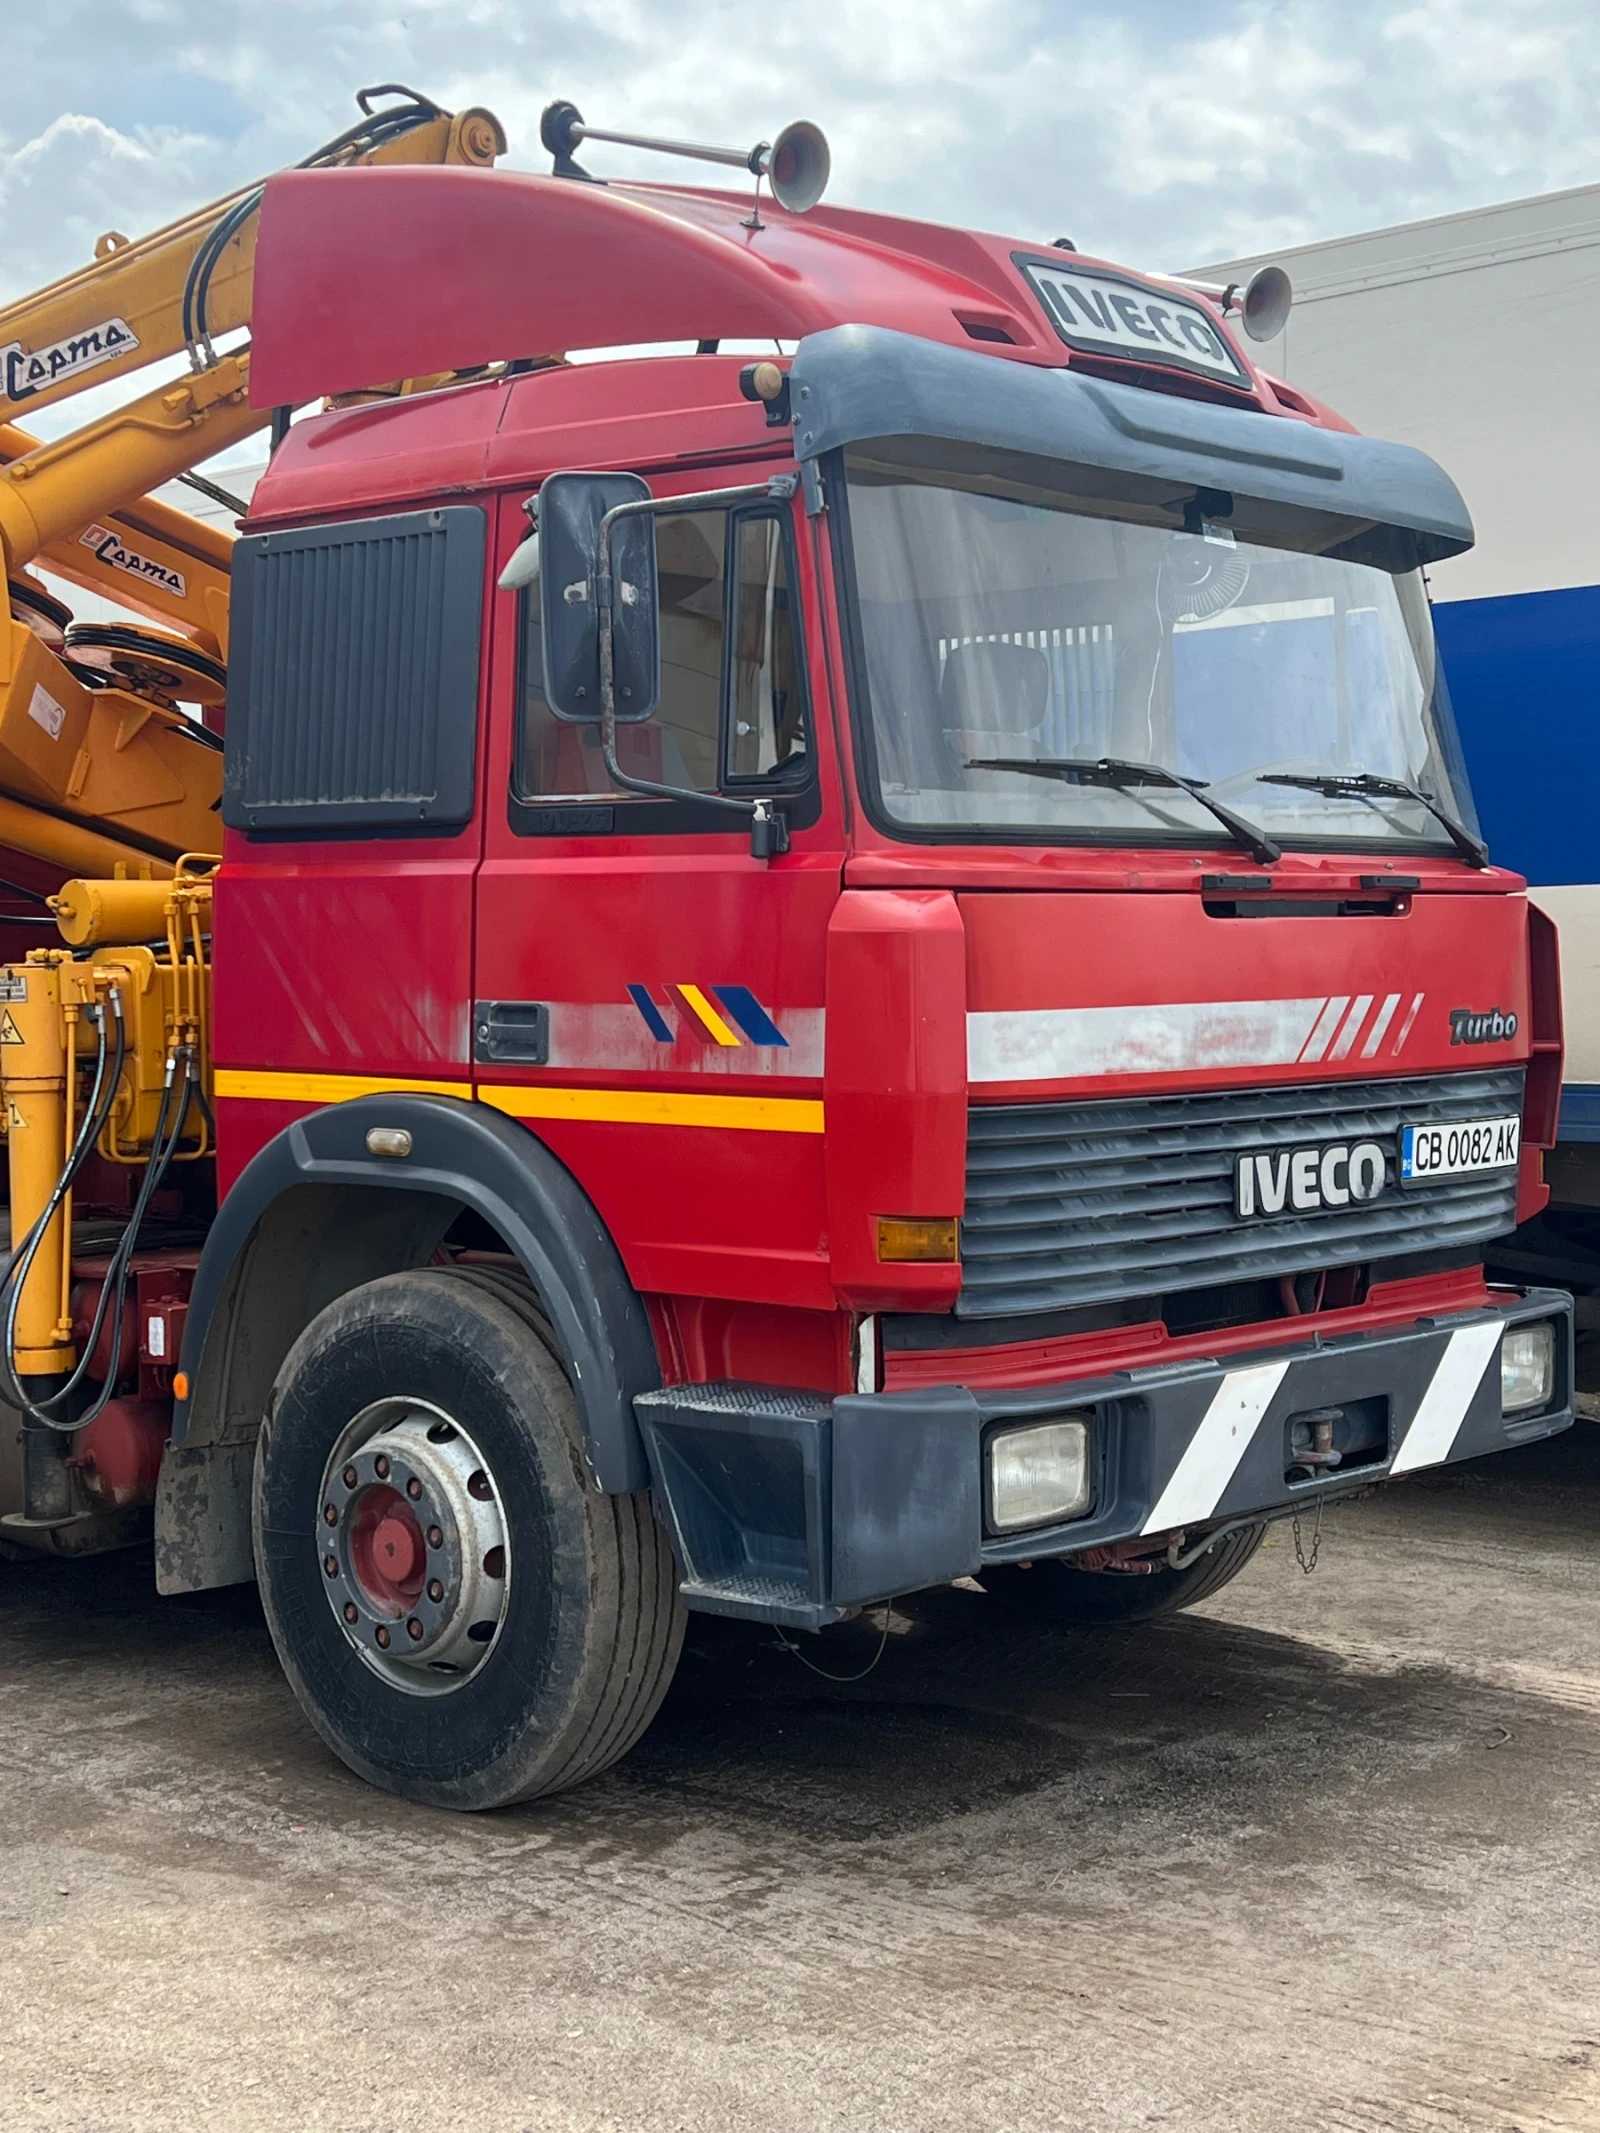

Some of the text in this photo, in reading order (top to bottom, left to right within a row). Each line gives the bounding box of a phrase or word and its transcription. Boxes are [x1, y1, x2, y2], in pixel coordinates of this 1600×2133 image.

[1038, 278, 1225, 361] IVECO
[1449, 1008, 1518, 1046] Turbo
[1415, 1123, 1517, 1171] CB 0082 AK
[1238, 1143, 1386, 1217] IVECO
